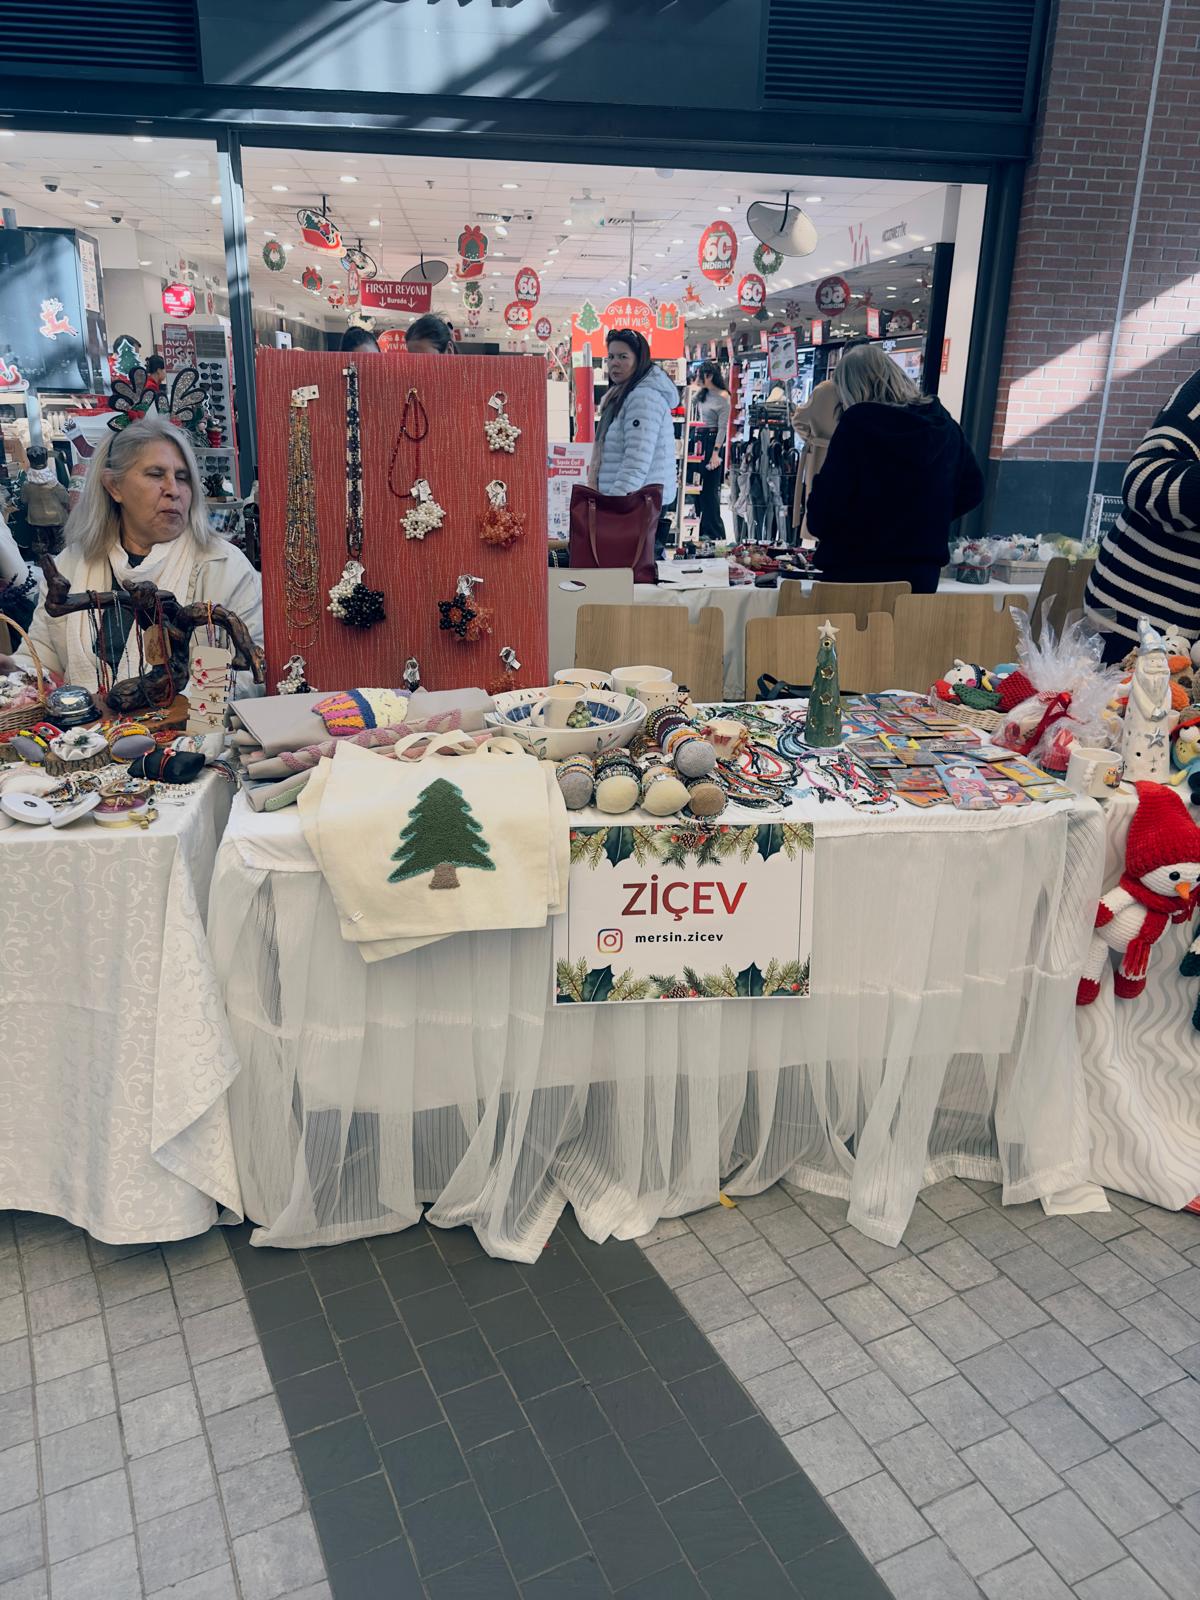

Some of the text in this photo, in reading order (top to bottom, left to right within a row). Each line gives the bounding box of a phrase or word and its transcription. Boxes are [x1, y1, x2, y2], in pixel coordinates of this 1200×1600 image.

[365, 283, 428, 297] FIRSAT REYONU
[621, 874, 748, 922] ZİÇEV
[634, 930, 725, 945] mersin.zicev
